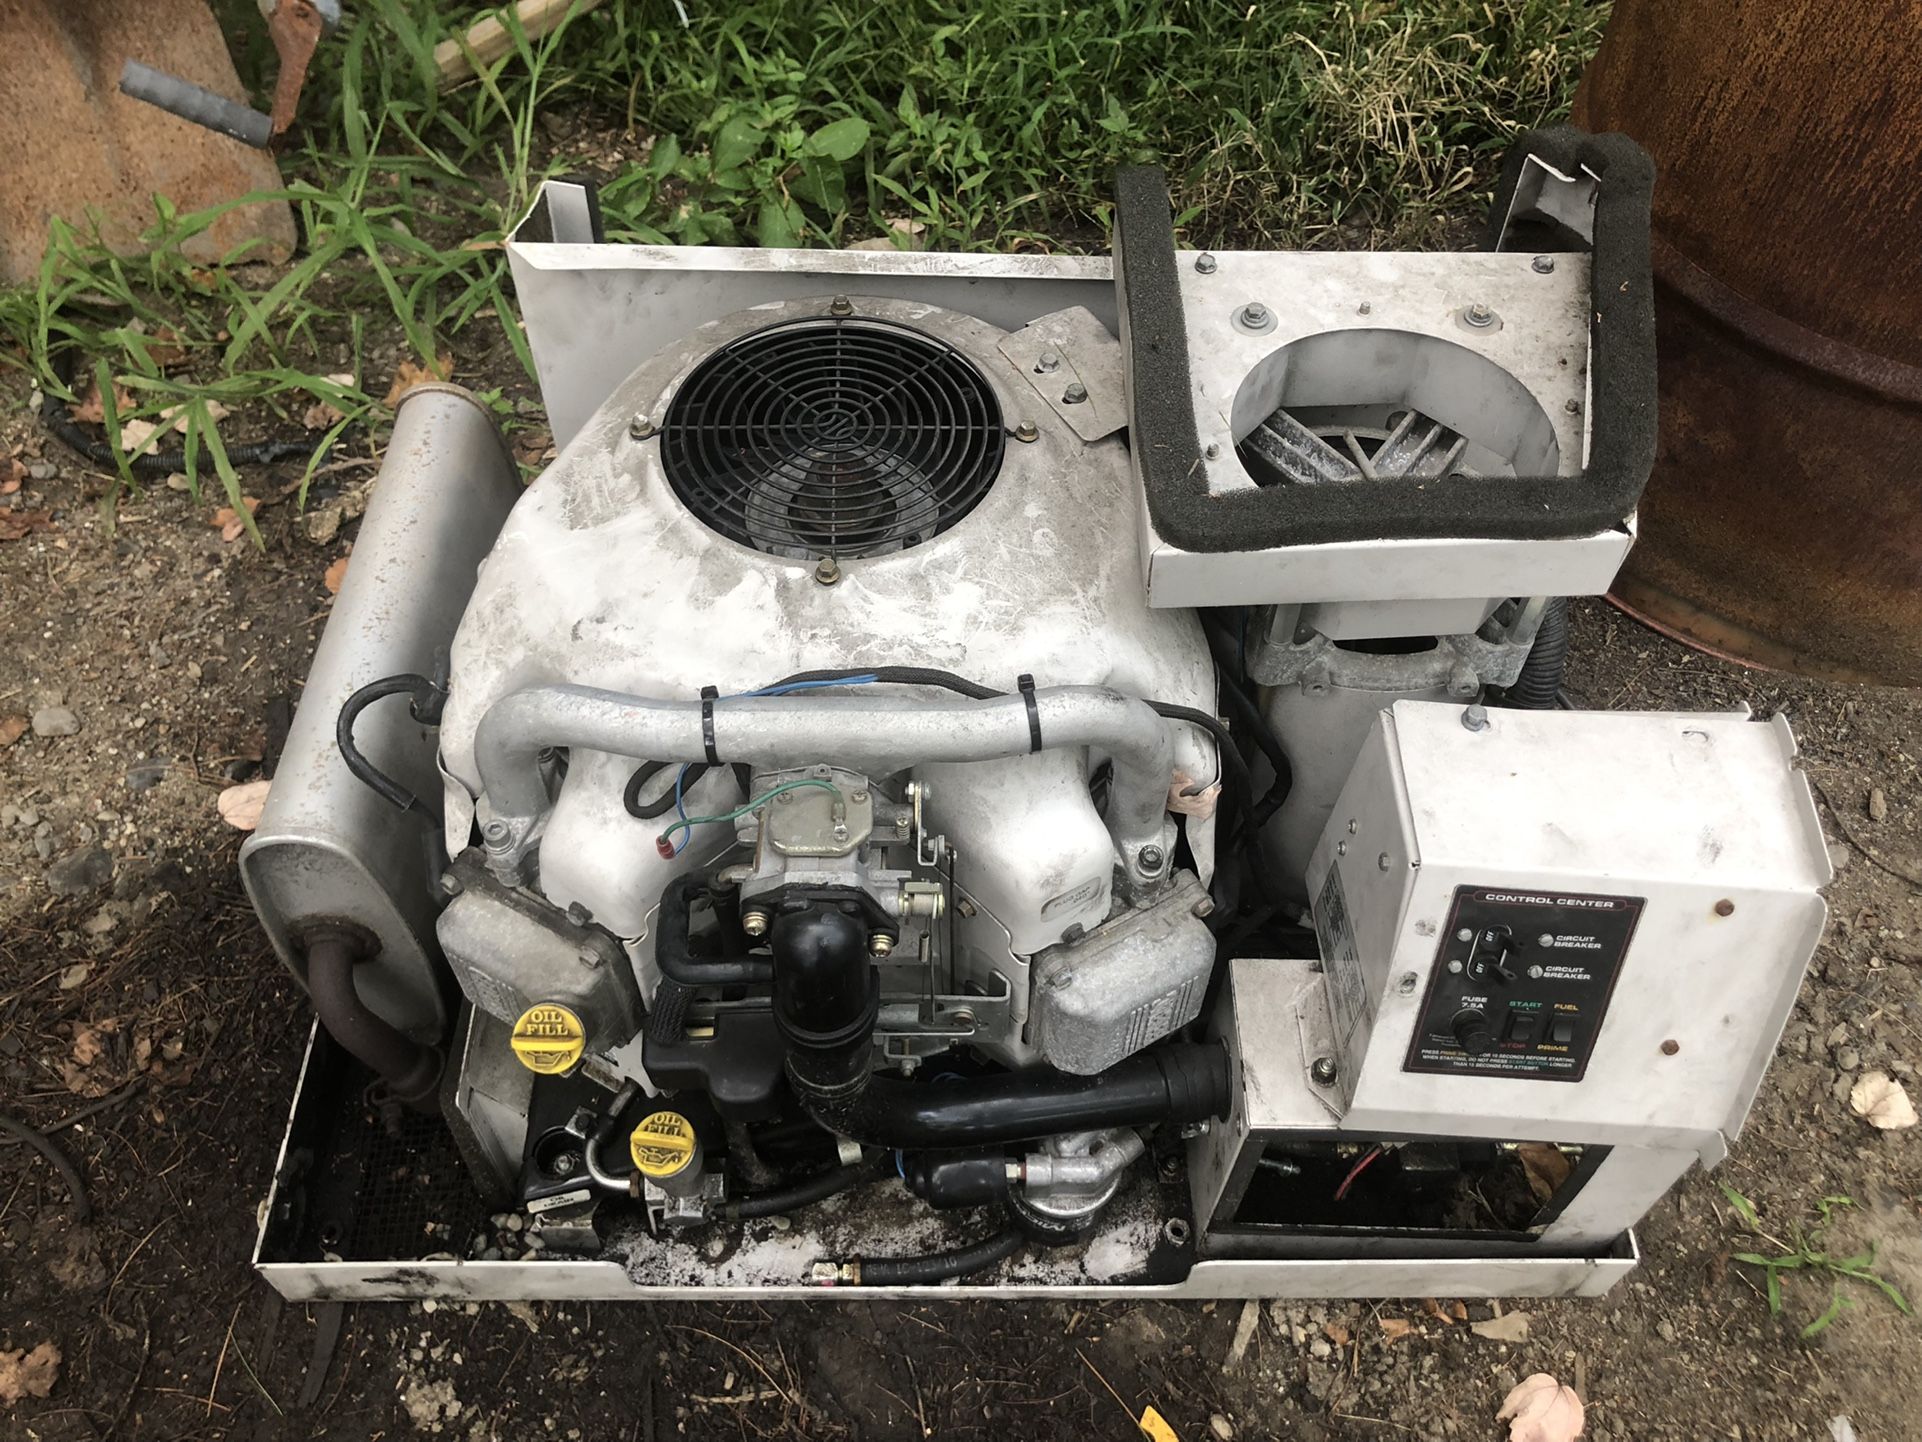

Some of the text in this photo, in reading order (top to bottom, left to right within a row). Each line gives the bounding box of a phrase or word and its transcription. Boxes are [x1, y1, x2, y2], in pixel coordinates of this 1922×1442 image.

[1485, 894, 1614, 908] CONTROL CENTER
[1554, 941, 1602, 949] BREAKER
[1545, 965, 1585, 973] CIRCUIT
[1543, 972, 1591, 980] BREAKER
[1554, 1003, 1579, 1011] FUEL
[531, 1010, 562, 1024] OIL
[526, 1024, 569, 1036] FILL
[1536, 1044, 1569, 1052] PRIME
[654, 1113, 681, 1126] OIL
